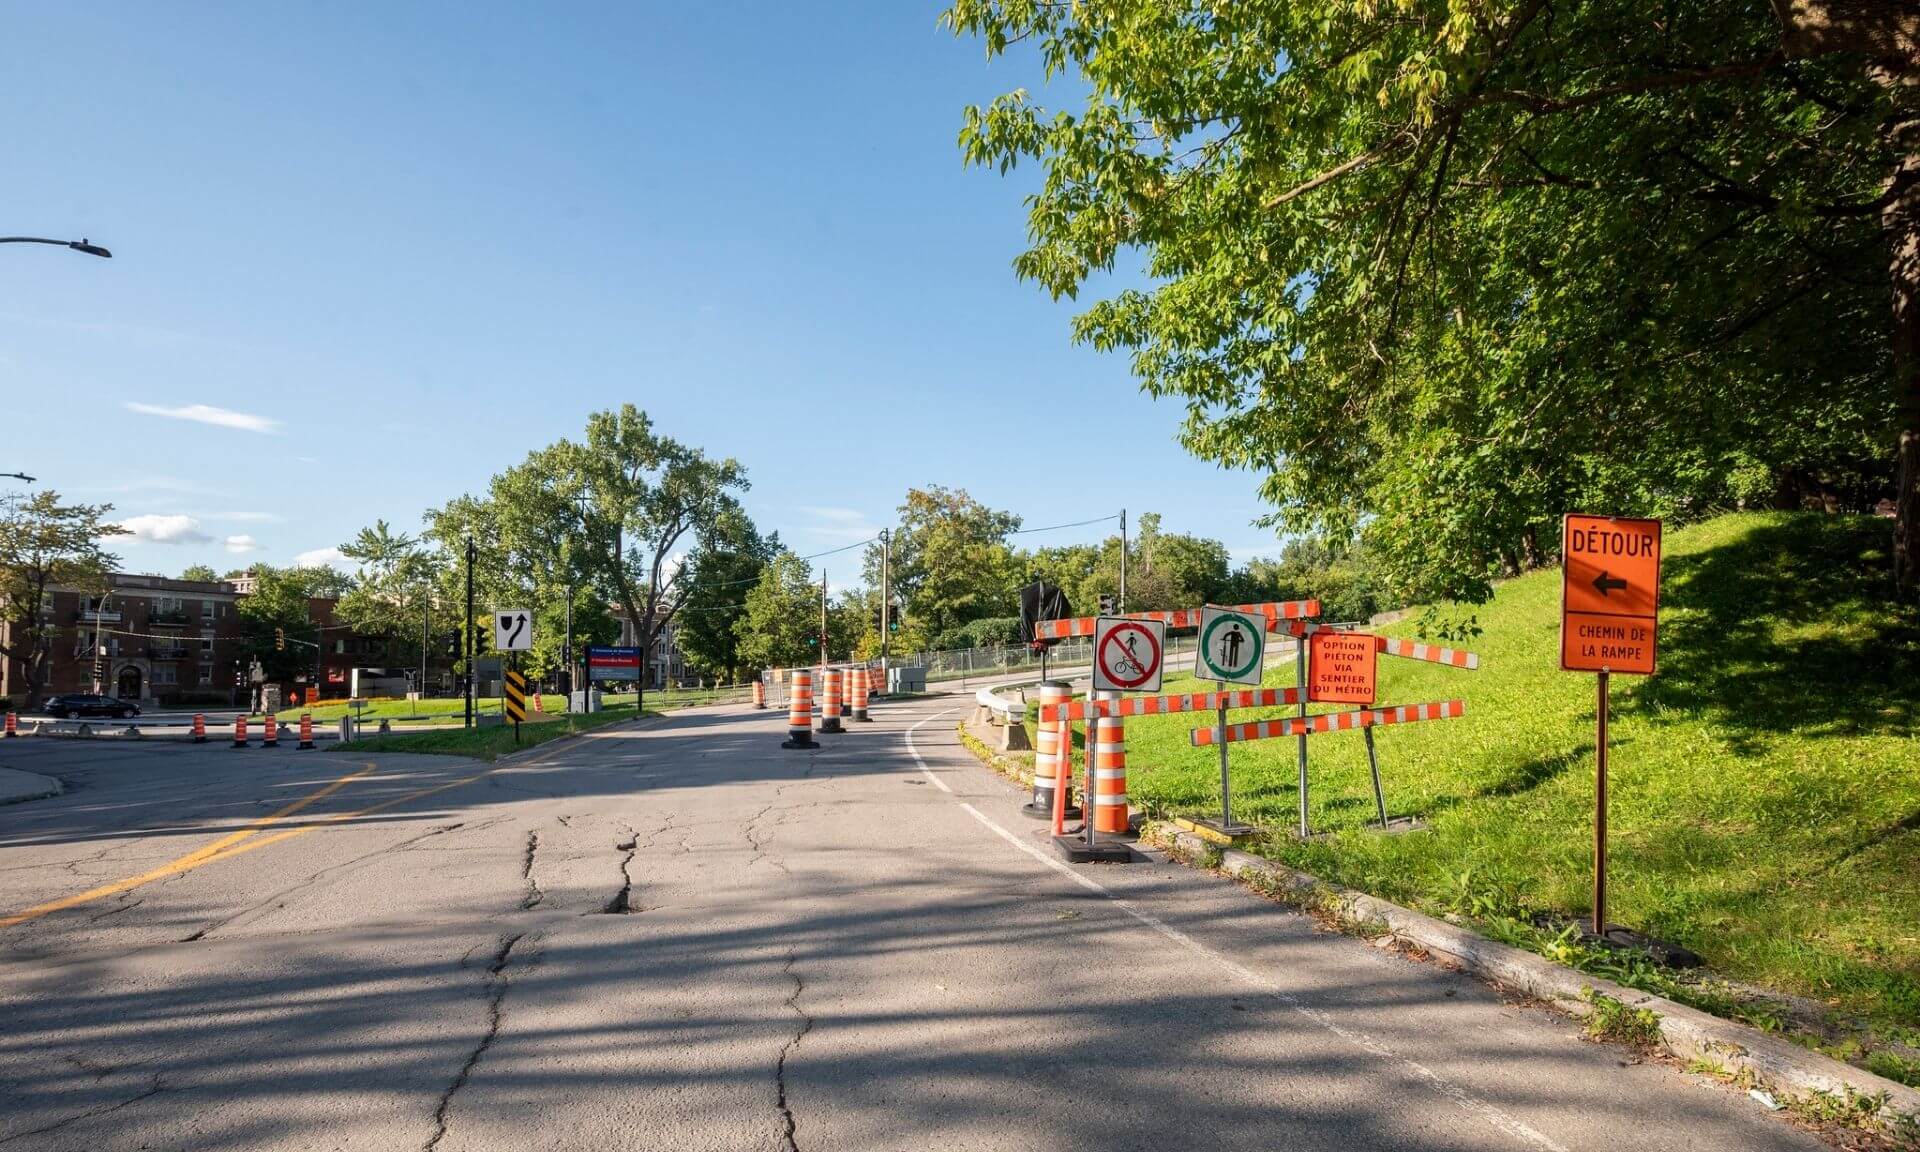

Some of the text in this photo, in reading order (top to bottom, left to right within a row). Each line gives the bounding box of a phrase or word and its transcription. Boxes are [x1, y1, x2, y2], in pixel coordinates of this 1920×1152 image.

[1572, 525, 1653, 558] DÉTOUR
[1579, 625, 1646, 641] CHEMIN DE
[1323, 642, 1365, 650] OPTION
[1324, 651, 1363, 661] PIÉTON
[1582, 644, 1642, 660] LA RAMPE
[1334, 664, 1353, 672] VIA
[1320, 675, 1365, 683] SENTIER
[1314, 684, 1371, 695] DU MÉTRO
